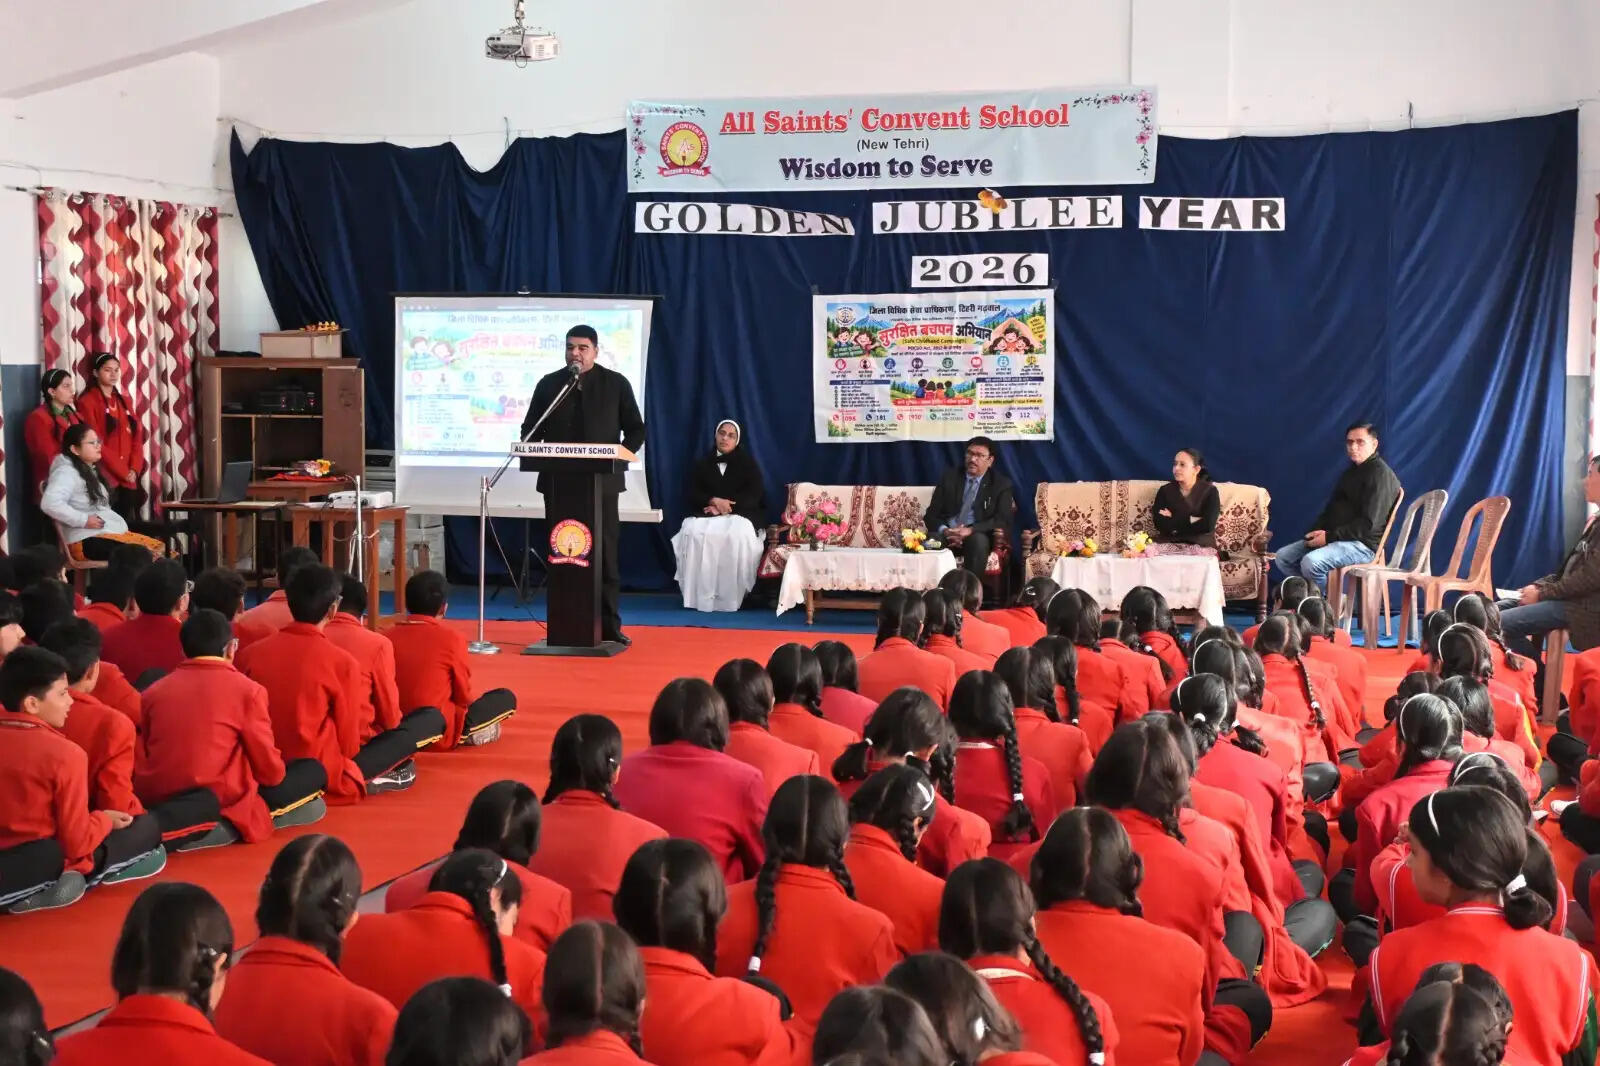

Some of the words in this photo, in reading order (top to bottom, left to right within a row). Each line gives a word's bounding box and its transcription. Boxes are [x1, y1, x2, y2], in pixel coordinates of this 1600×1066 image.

[719, 112, 756, 135] All
[764, 109, 853, 134] Saints'
[861, 106, 971, 131] Convent
[979, 103, 1070, 129] School
[856, 139, 889, 152] (New
[893, 138, 930, 151] Tehri)
[779, 157, 881, 180] Wisdom
[887, 157, 914, 178] to
[920, 155, 993, 177] Serve
[643, 202, 850, 234] GOLDEN
[880, 196, 1118, 231] JUBILEE
[1140, 198, 1281, 230] YEAR
[919, 253, 1036, 285] 2026
[869, 306, 886, 315] जिला
[887, 305, 908, 315] विधिक
[958, 304, 975, 313] टिहरी
[878, 322, 917, 347] सुरक्षित
[920, 323, 954, 336] बचपन
[955, 321, 993, 341] अभियान
[555, 446, 588, 454] CONVENT
[588, 447, 616, 455] SCHOOL
